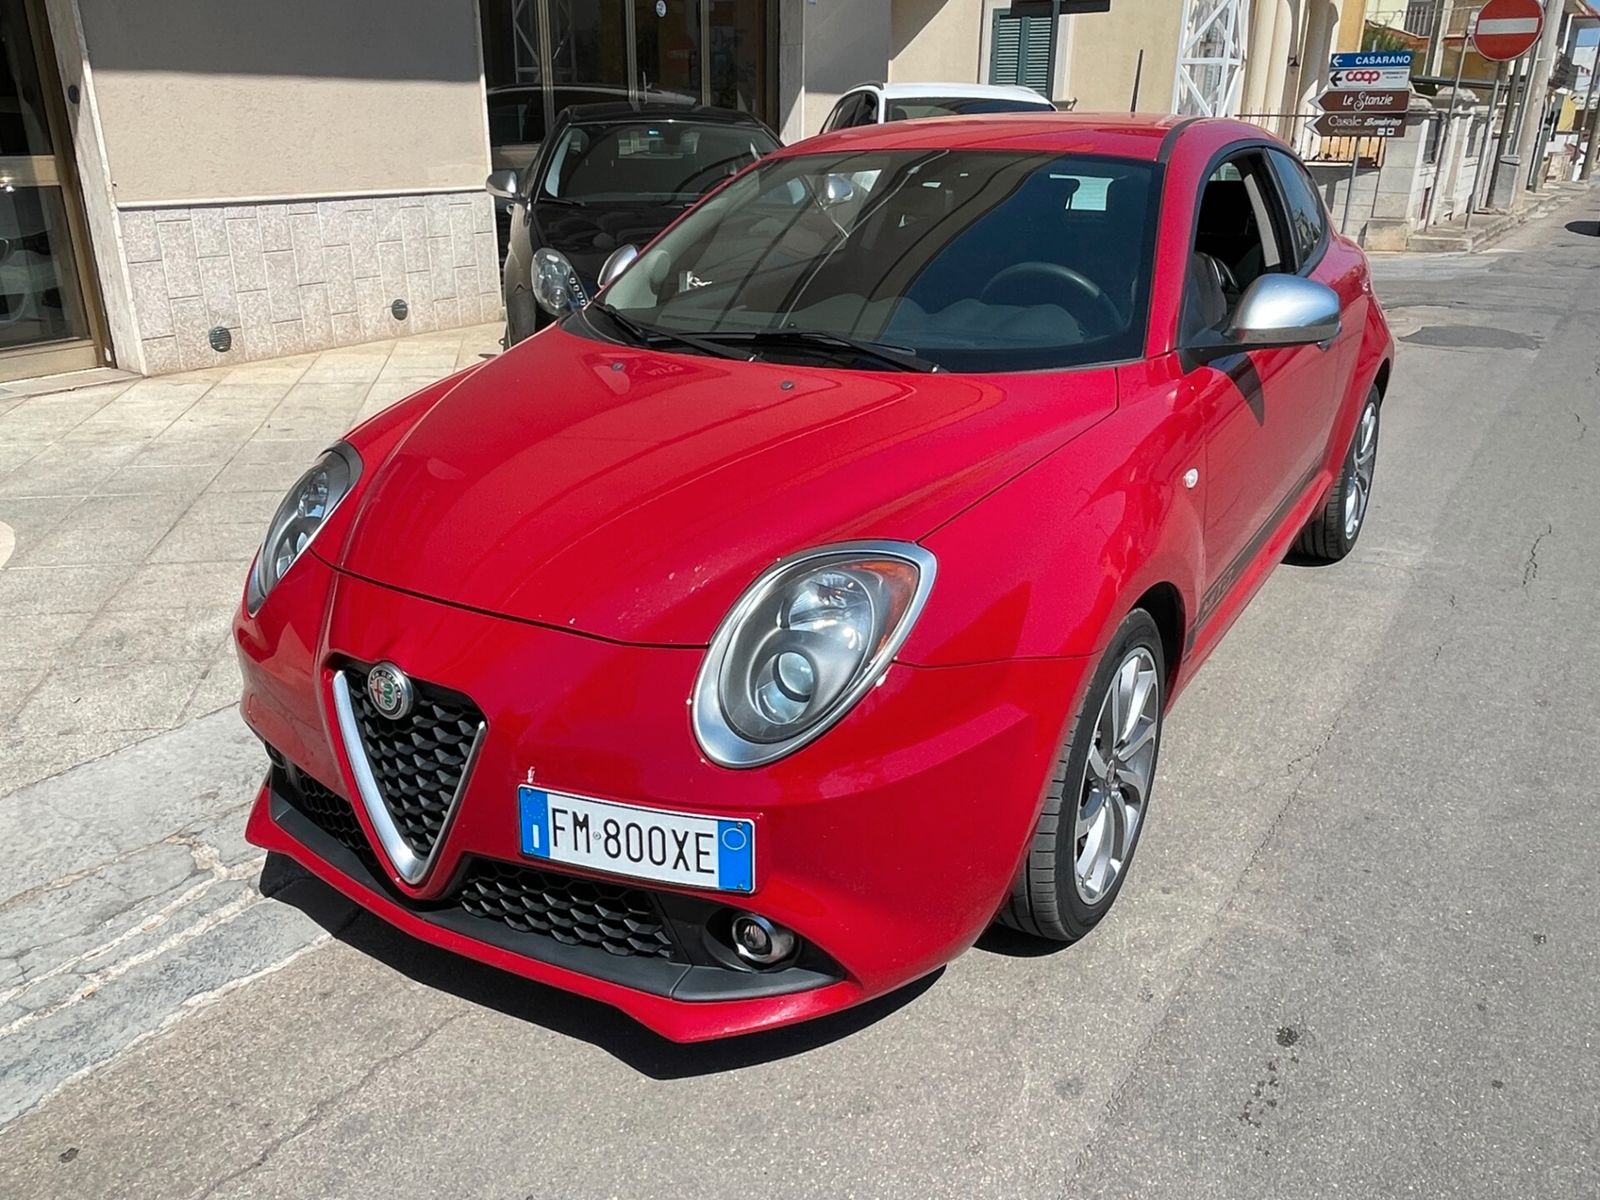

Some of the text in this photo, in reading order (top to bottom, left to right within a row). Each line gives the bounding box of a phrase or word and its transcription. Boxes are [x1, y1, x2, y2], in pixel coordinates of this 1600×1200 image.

[1355, 55, 1410, 64] CASARANO
[1345, 70, 1380, 84] coop
[1342, 91, 1393, 111] Le Stanzie
[1328, 114, 1362, 127] Casale
[551, 807, 591, 854] FM
